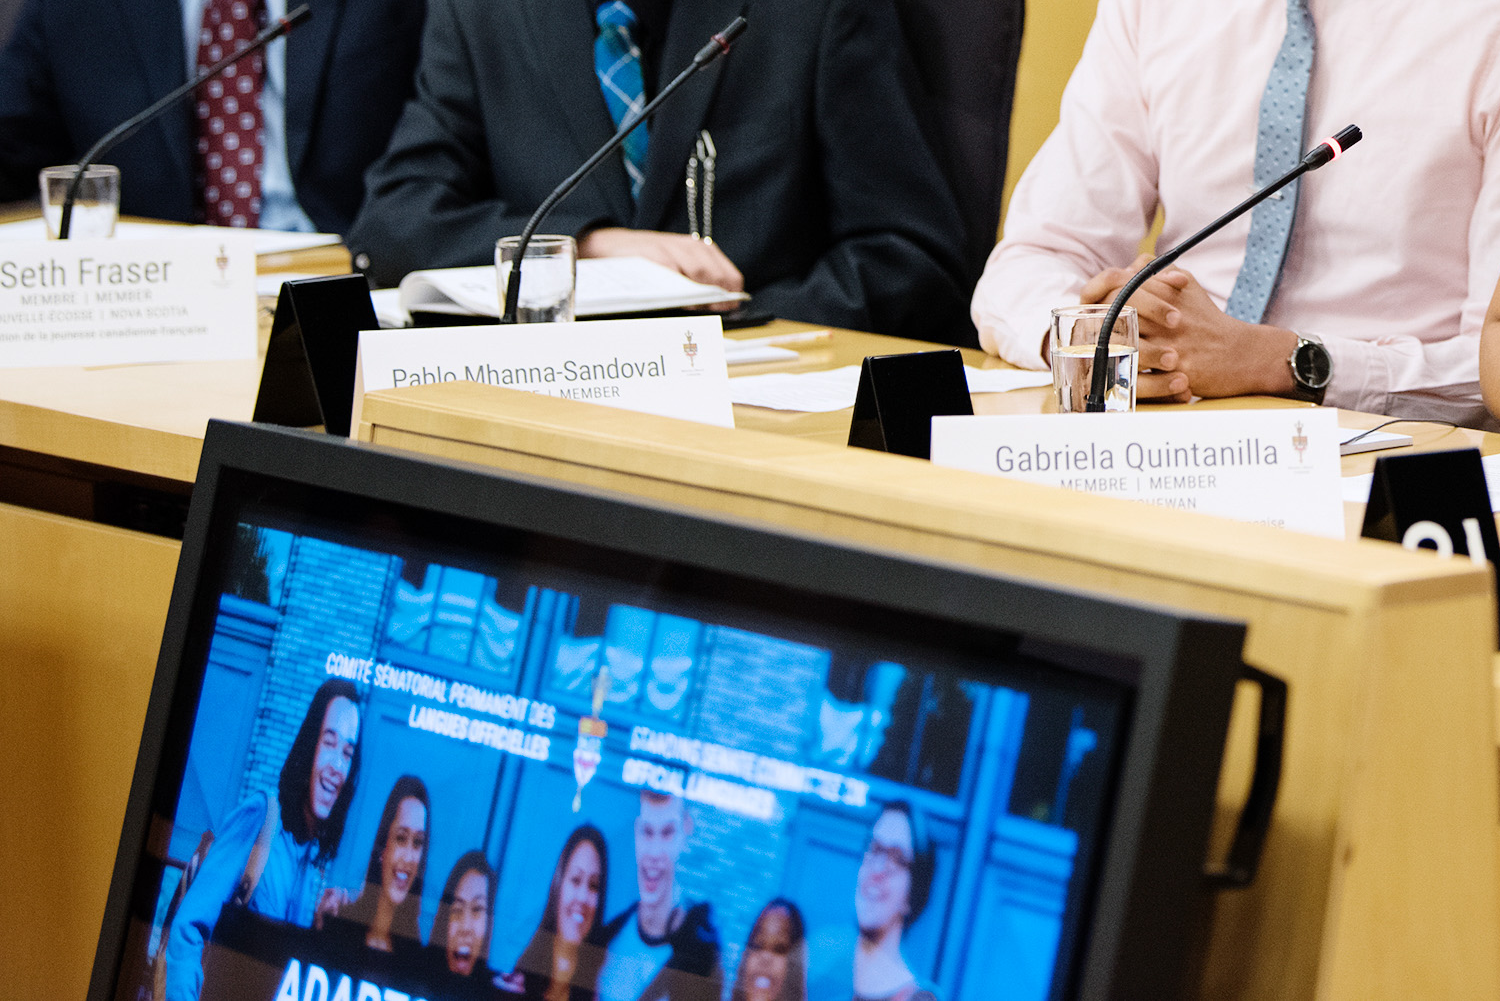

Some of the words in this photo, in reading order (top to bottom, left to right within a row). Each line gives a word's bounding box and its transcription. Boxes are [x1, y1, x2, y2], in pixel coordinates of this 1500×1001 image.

[1, 258, 66, 289] Seth
[78, 257, 172, 286] Fraser
[21, 293, 76, 306] MEMBRE
[96, 289, 153, 303] MEMBER
[392, 366, 457, 388] Pablo
[464, 355, 666, 385] Mhanna-Sandoval
[560, 386, 621, 399] MEMBER
[996, 443, 1114, 472] Gabriela
[1126, 438, 1278, 471] Quintanilla
[1060, 477, 1127, 492] MEMBRE
[1150, 475, 1217, 490] MEMBER
[325, 652, 374, 685] COMITÉ
[374, 661, 447, 703] SÉNATORIAL
[449, 681, 531, 722] PERMANENT
